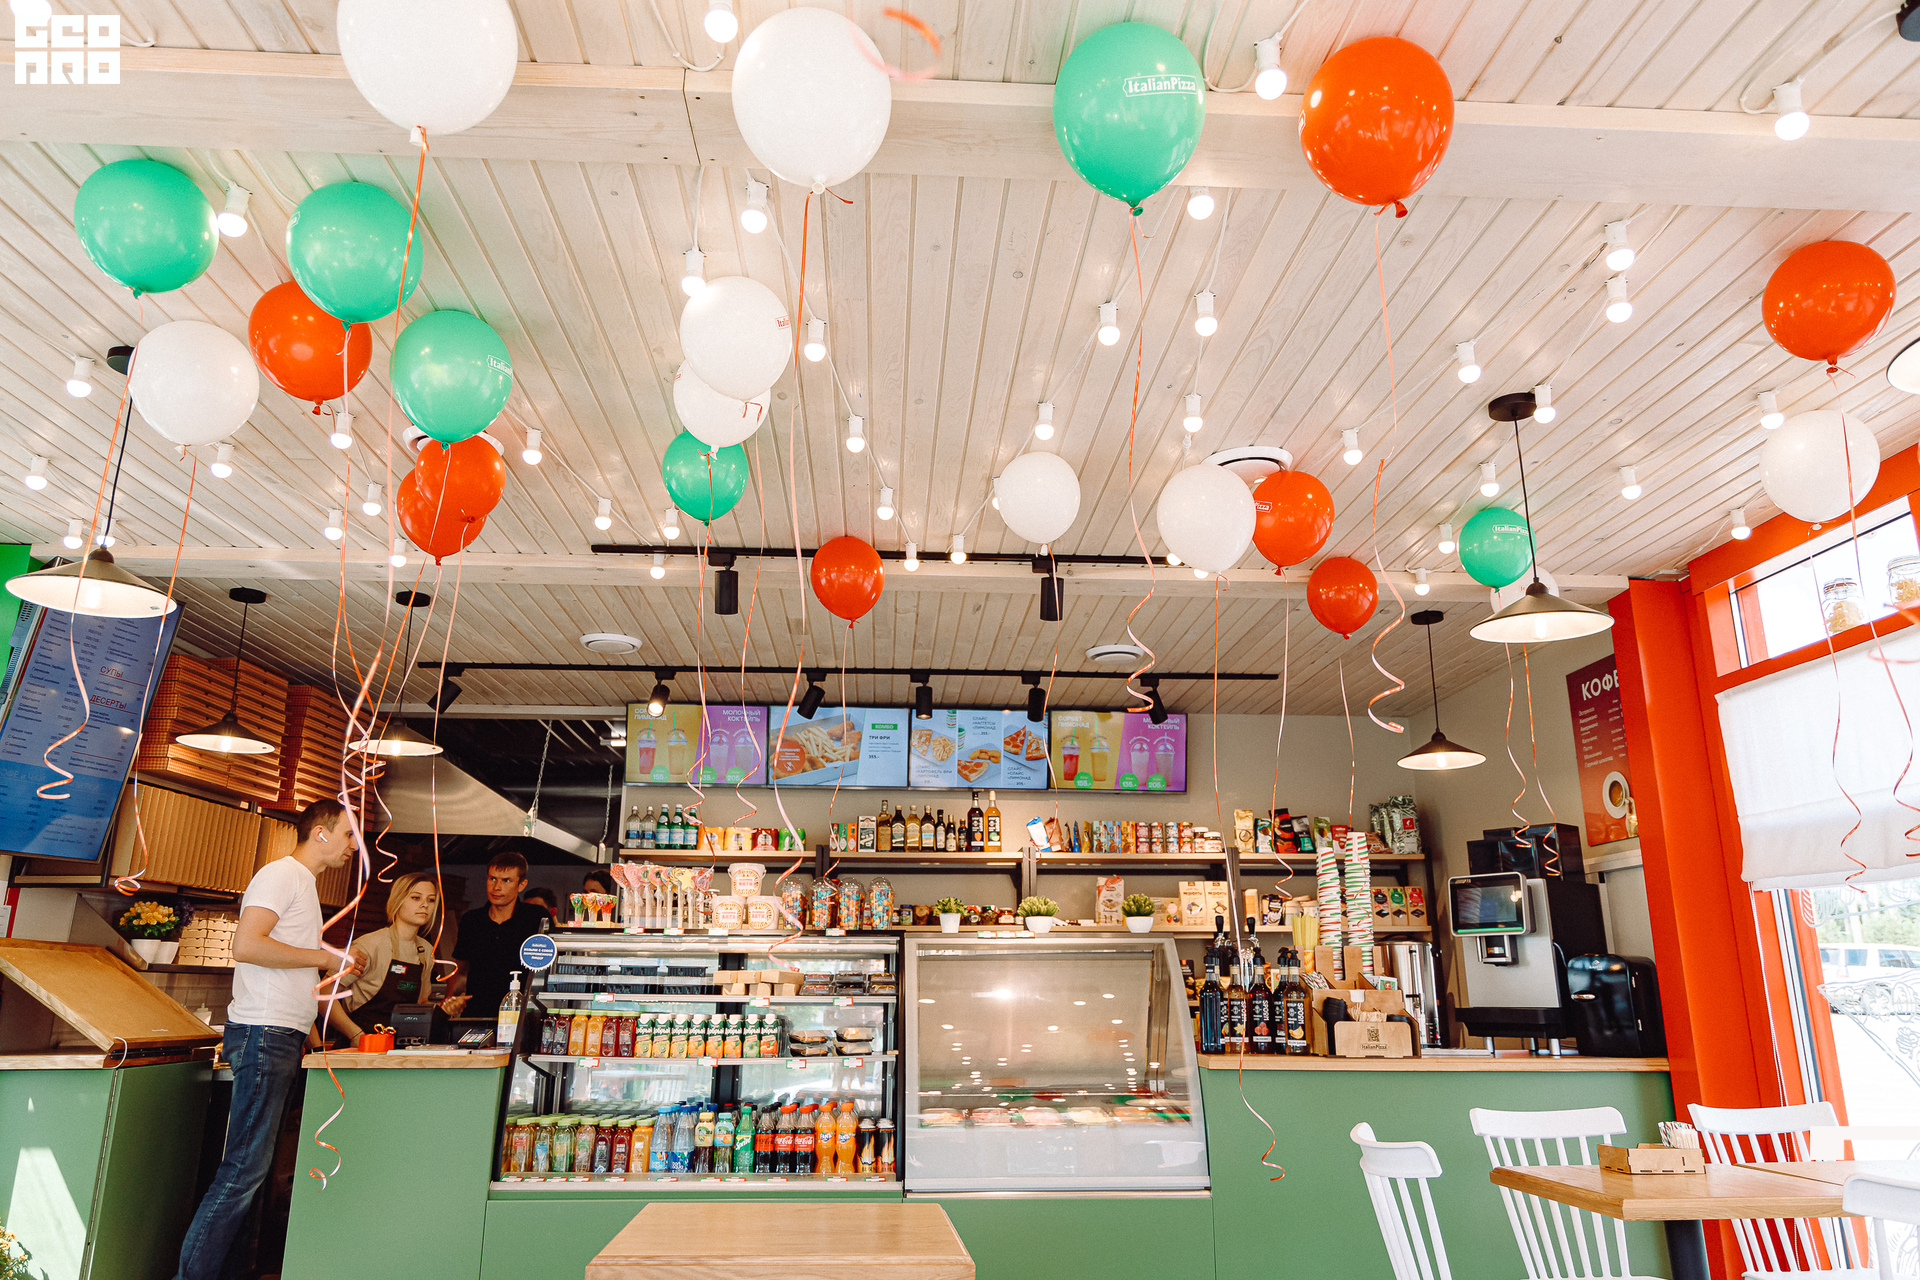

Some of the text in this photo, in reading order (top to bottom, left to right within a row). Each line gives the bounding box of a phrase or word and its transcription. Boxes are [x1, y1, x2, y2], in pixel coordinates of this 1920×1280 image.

[1128, 76, 1196, 94] ItalianPizza
[100, 665, 124, 678] СУПЫ
[89, 694, 127, 709] ДЕСЕРТЫ
[735, 1137, 751, 1150] Sprite
